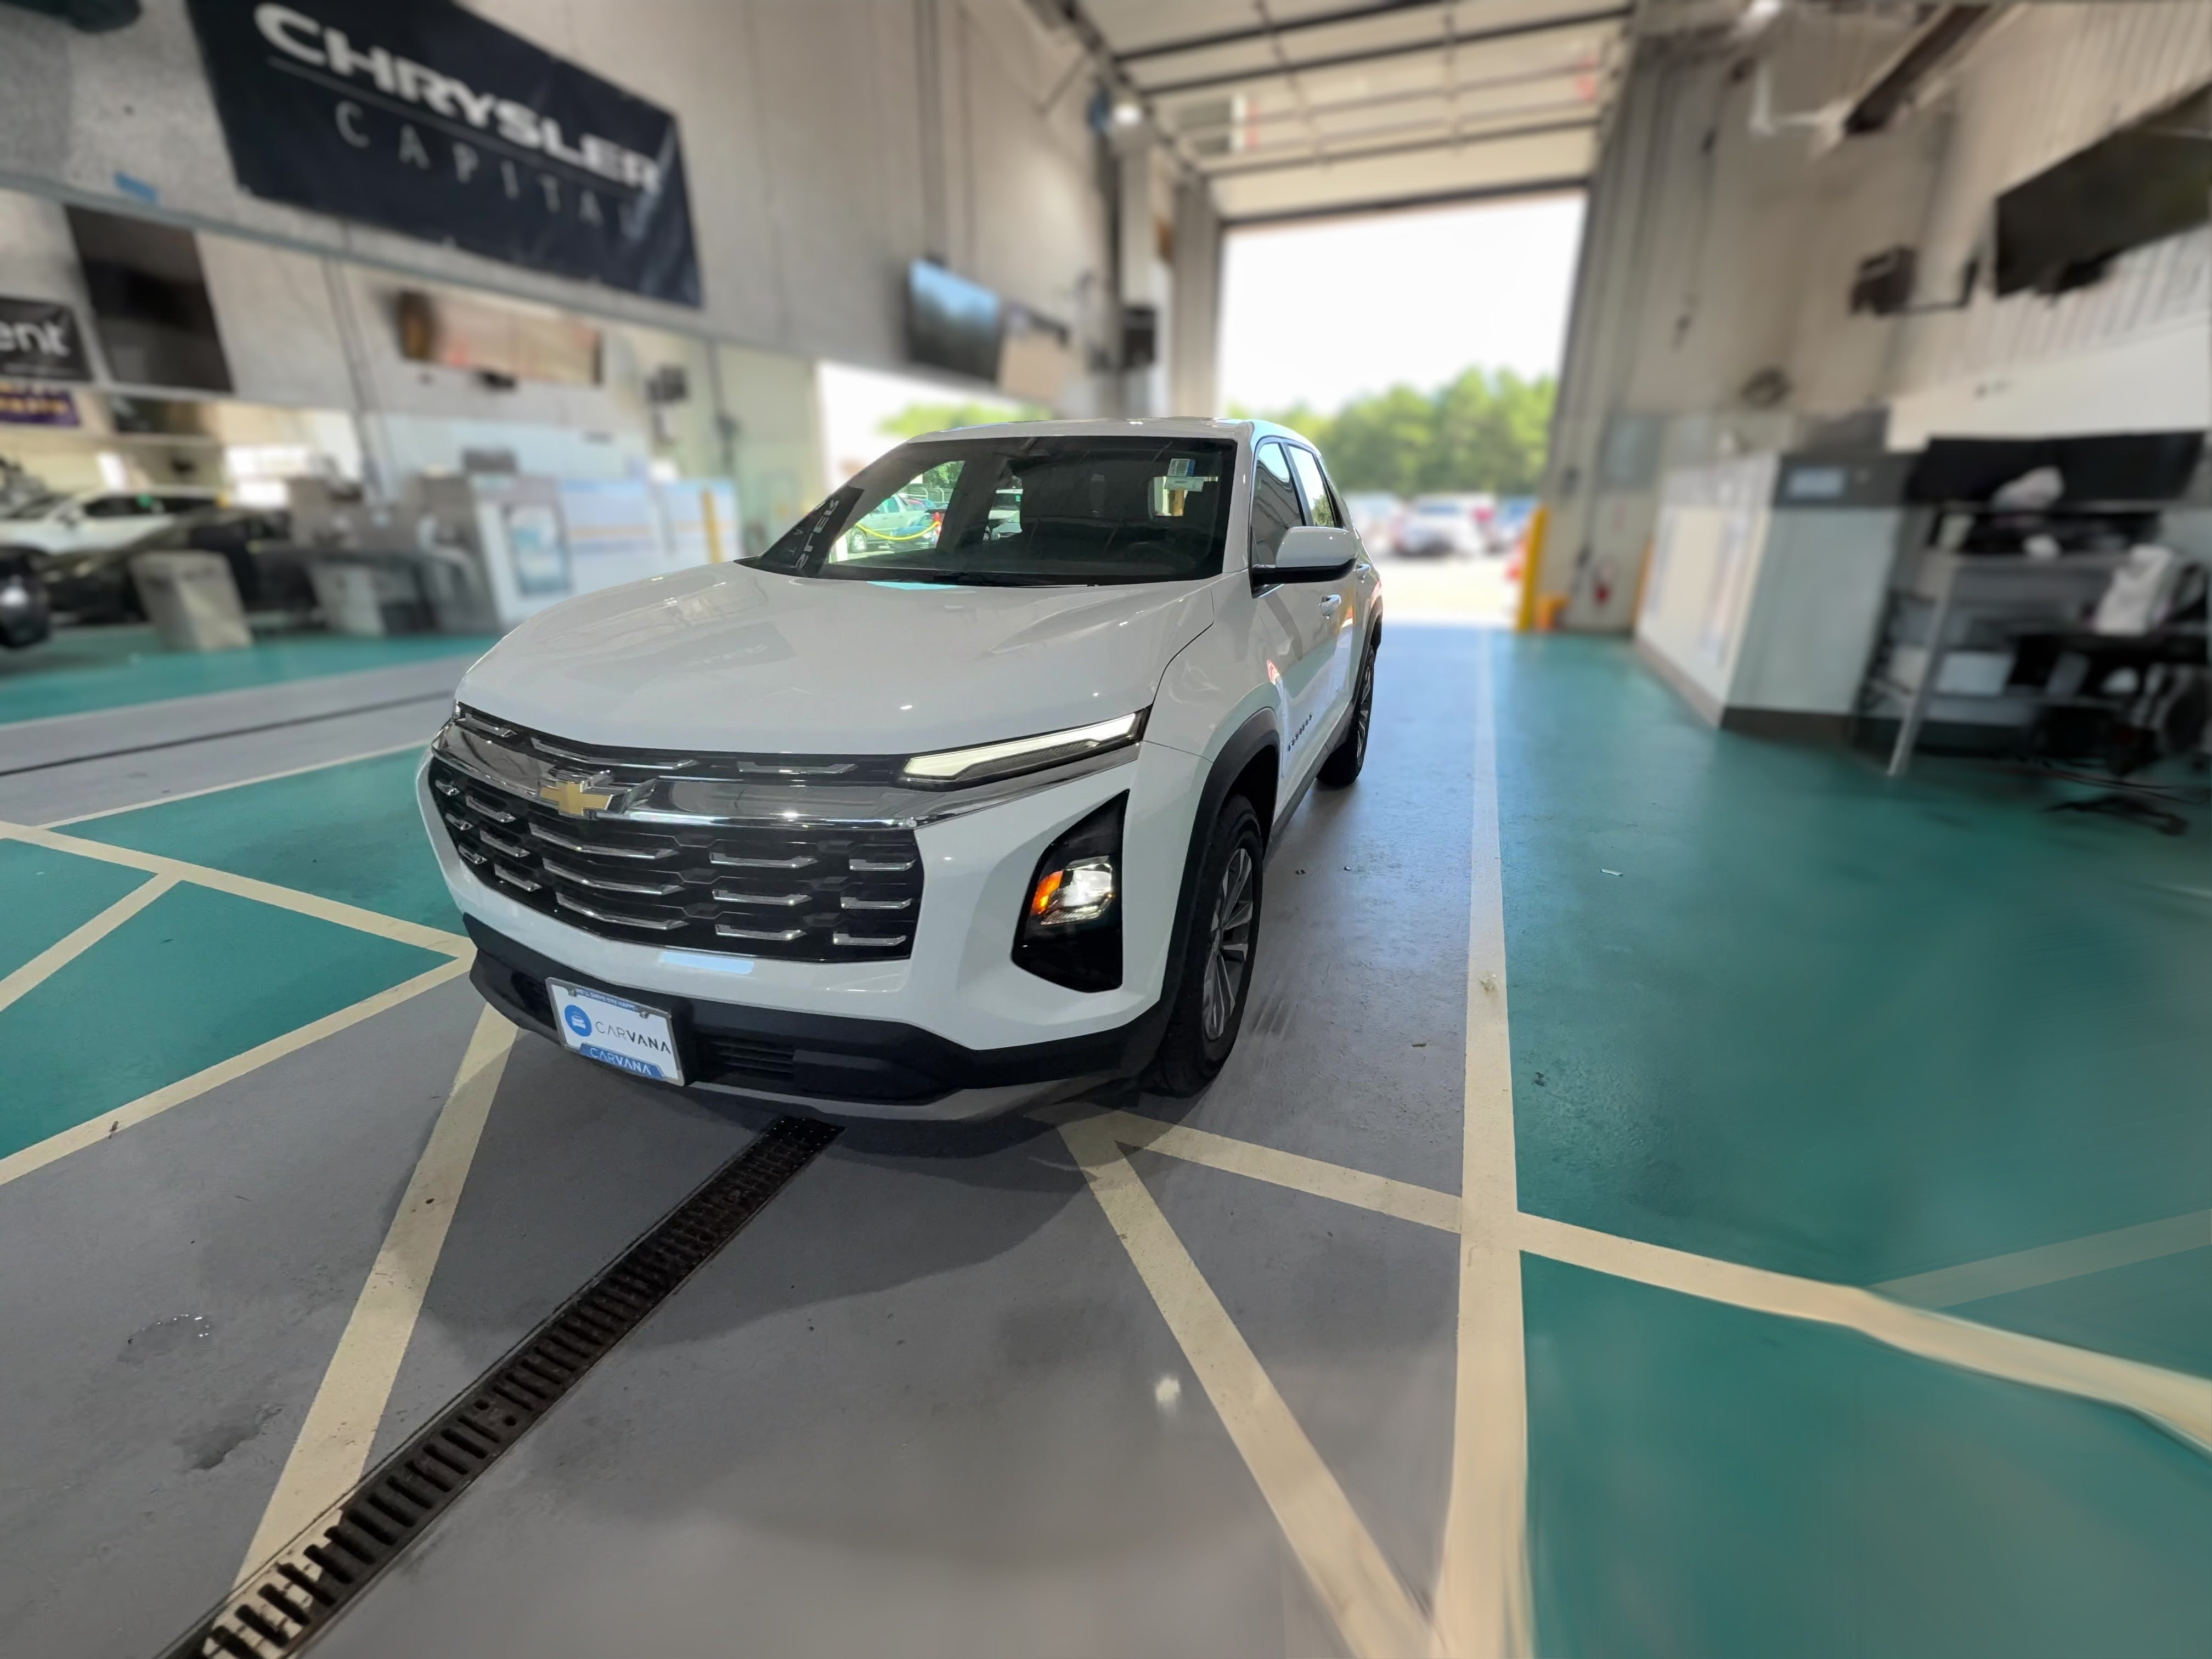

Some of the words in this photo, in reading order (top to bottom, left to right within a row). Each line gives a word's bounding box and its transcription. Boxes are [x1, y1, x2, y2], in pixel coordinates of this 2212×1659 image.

[254, 2, 660, 192] CHRYSLER
[595, 1021, 671, 1054] CARVANA
[590, 1047, 652, 1075] CARVANA
